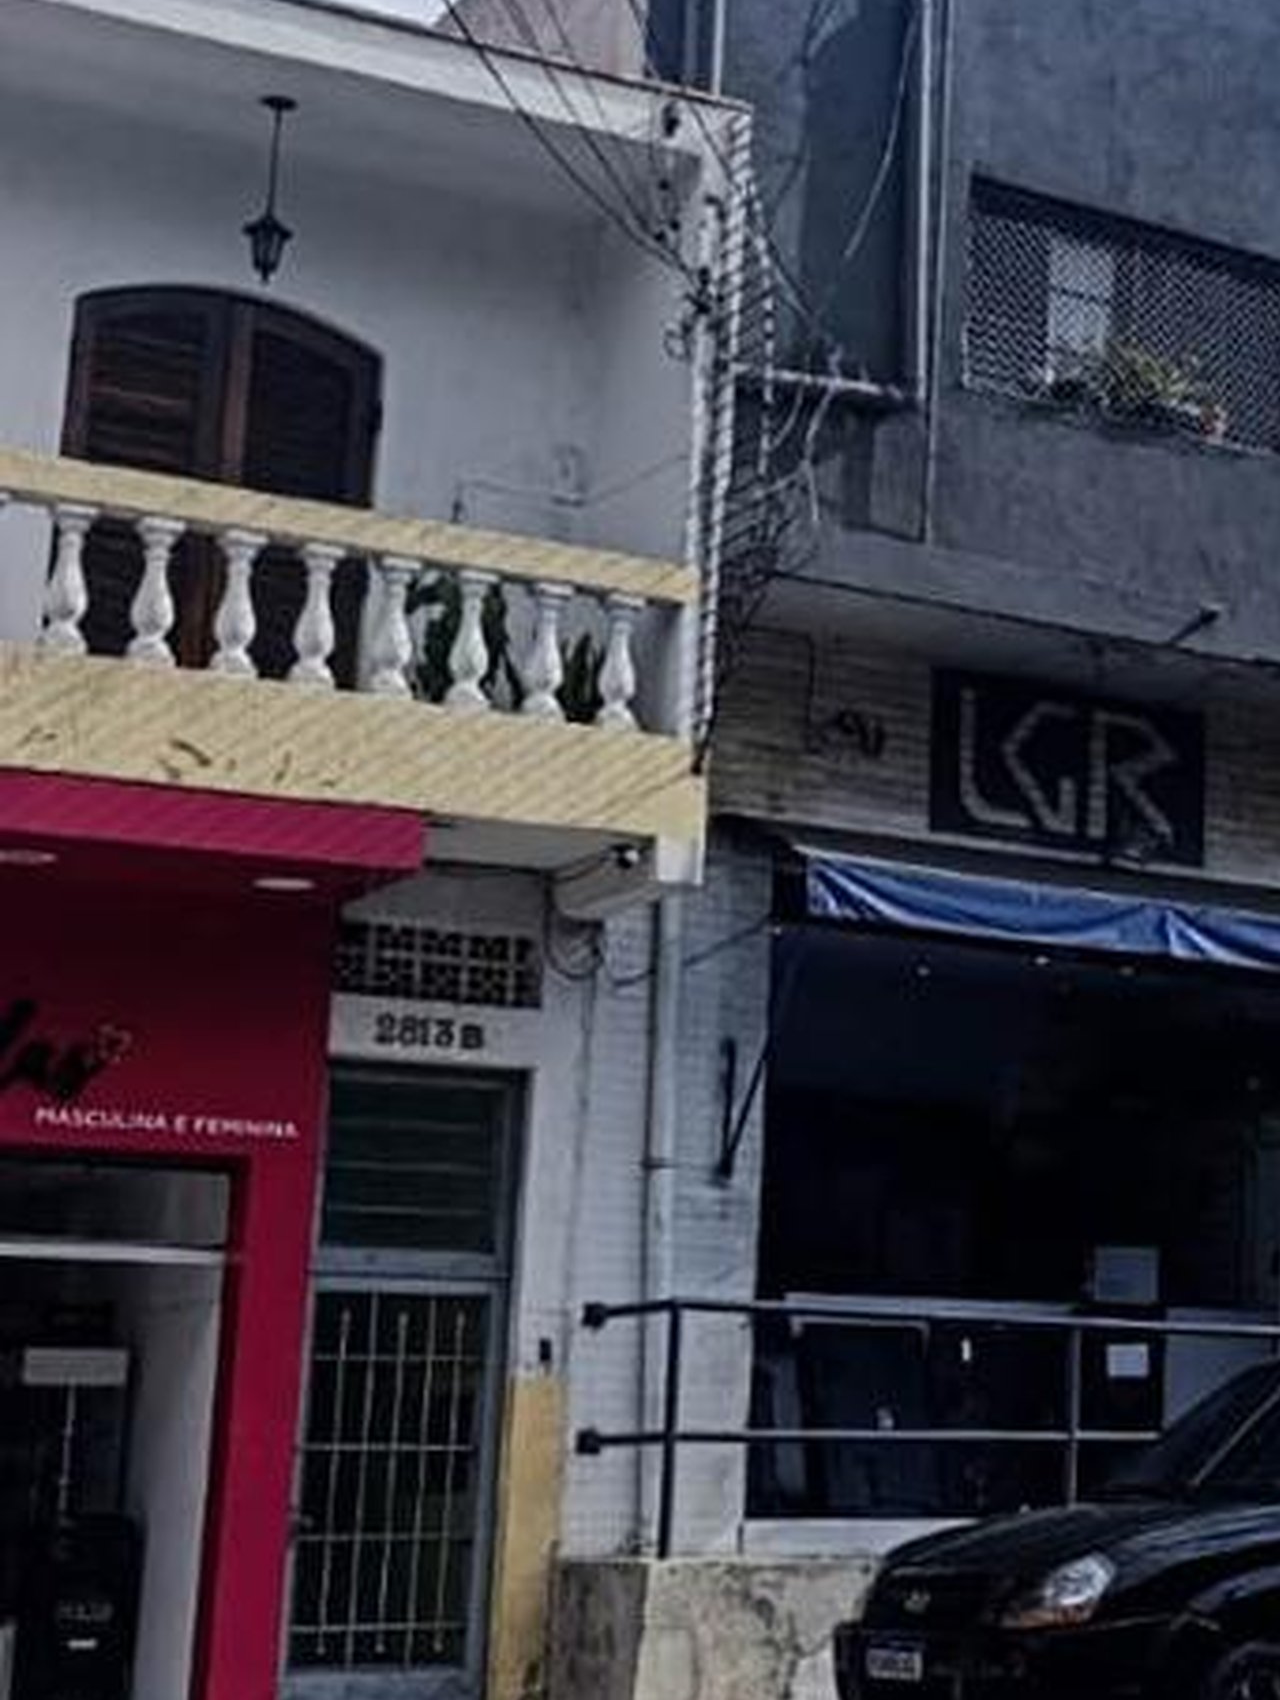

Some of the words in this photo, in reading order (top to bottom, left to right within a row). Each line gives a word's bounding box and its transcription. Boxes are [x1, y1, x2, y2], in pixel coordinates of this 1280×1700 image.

[374, 1011, 455, 1048] 2813
[460, 1022, 485, 1050] B
[34, 1107, 168, 1131] MASCULINA
[174, 1115, 187, 1134] E
[193, 1117, 299, 1139] FEMININA
